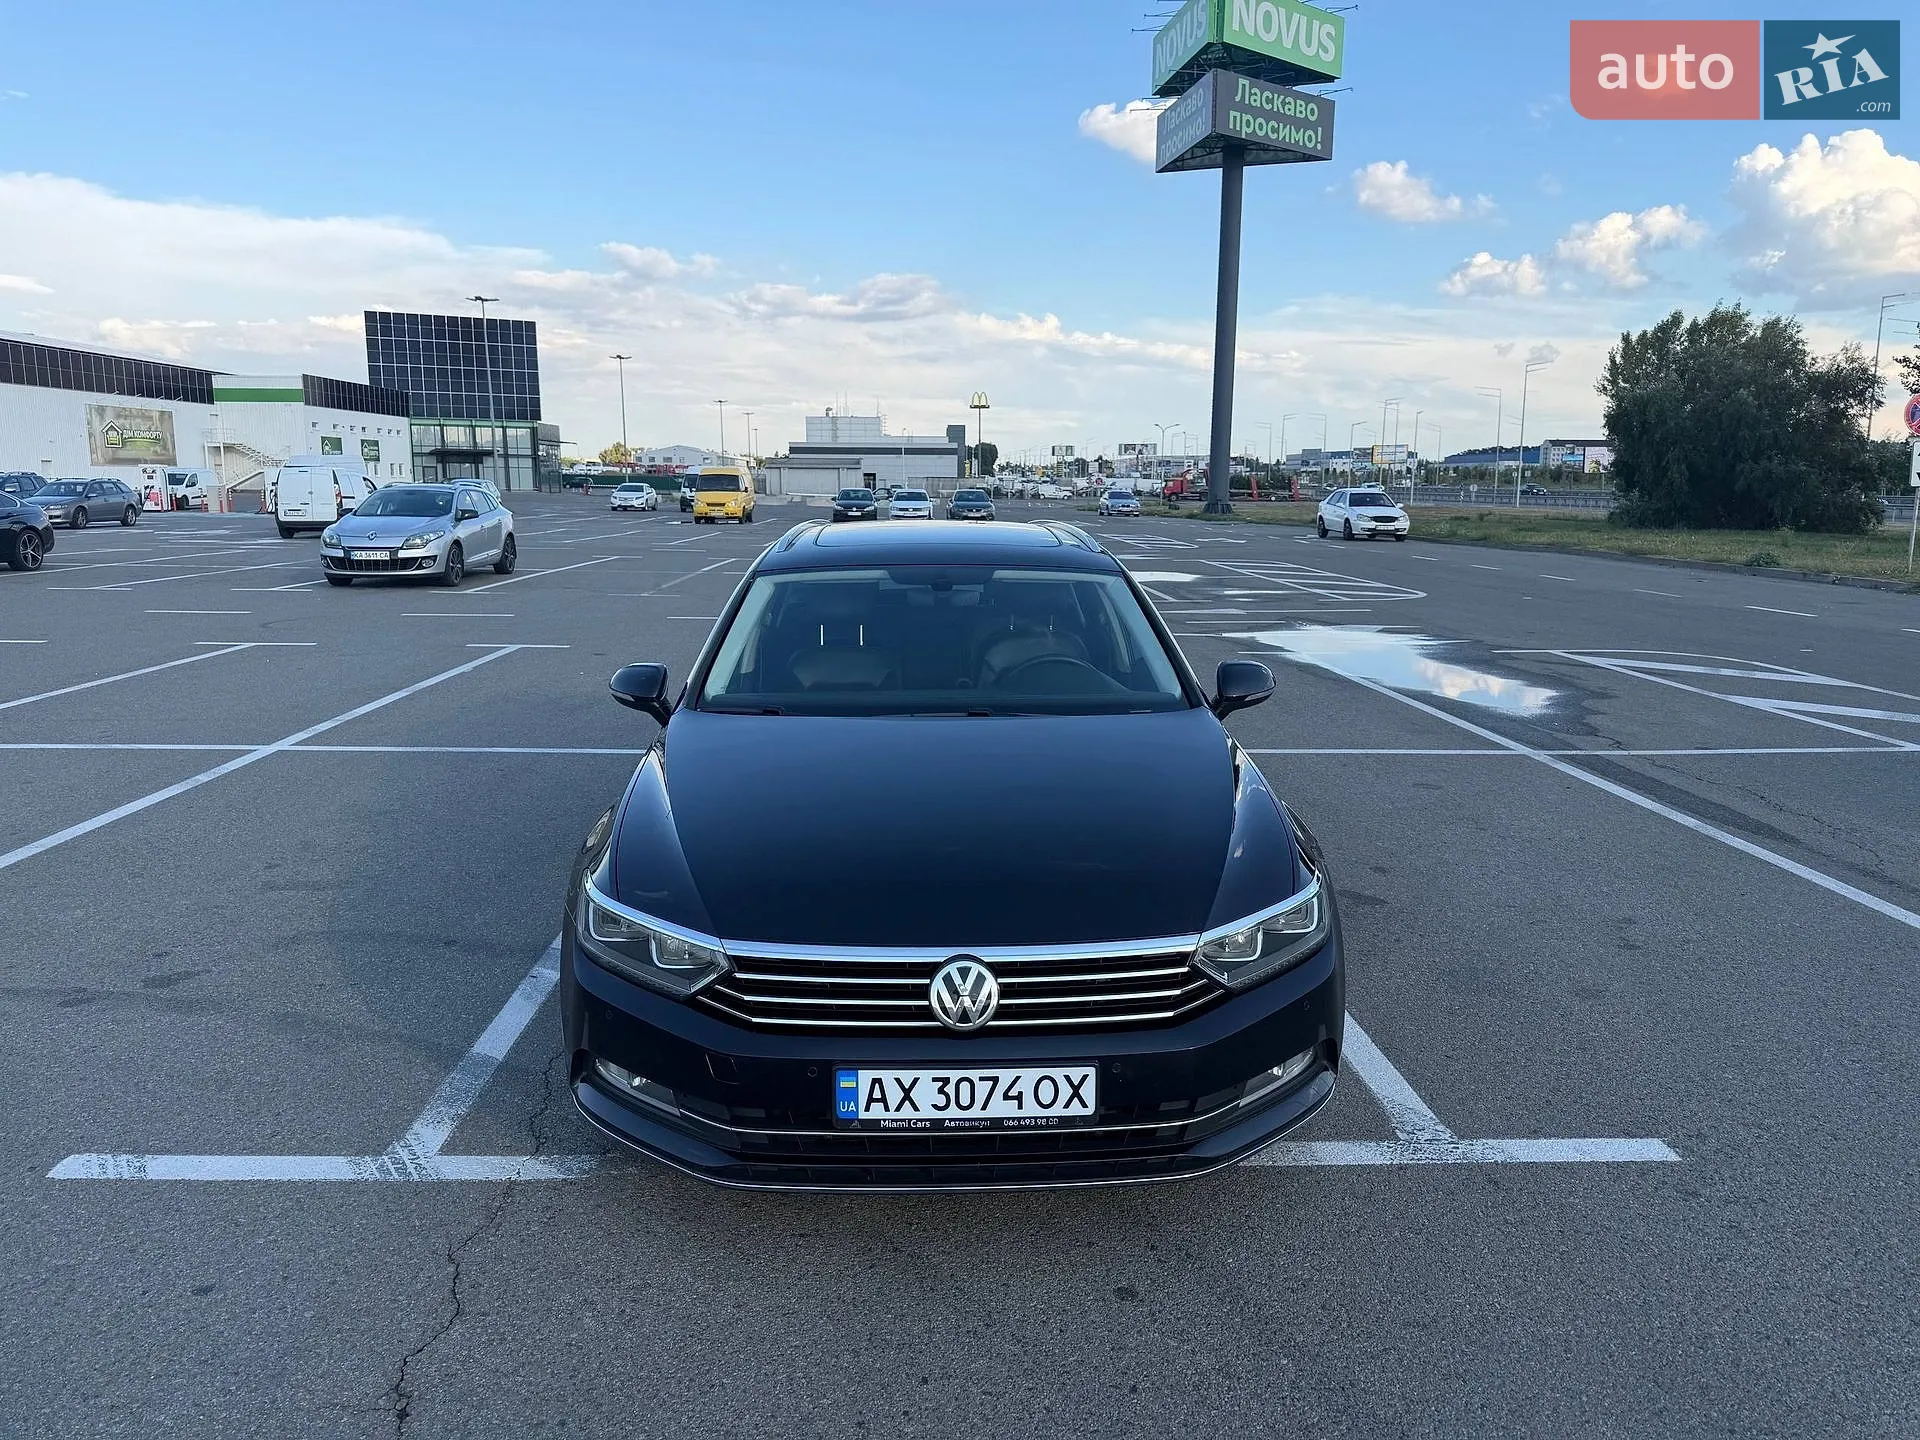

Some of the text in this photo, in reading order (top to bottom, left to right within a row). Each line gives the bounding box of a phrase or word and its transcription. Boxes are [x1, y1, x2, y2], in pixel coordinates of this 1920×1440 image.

[1154, 2, 1207, 80] NOVUS
[1231, 0, 1336, 62] NOVUS
[1163, 86, 1204, 134] Ласкаво
[1234, 77, 1319, 122] Ласкаво
[1228, 110, 1323, 151] просимо!
[839, 1101, 857, 1112] UA
[863, 1073, 1090, 1113] AX 3074 OX
[880, 1119, 931, 1128] Miami Cars
[1020, 1118, 1035, 1126] 493
